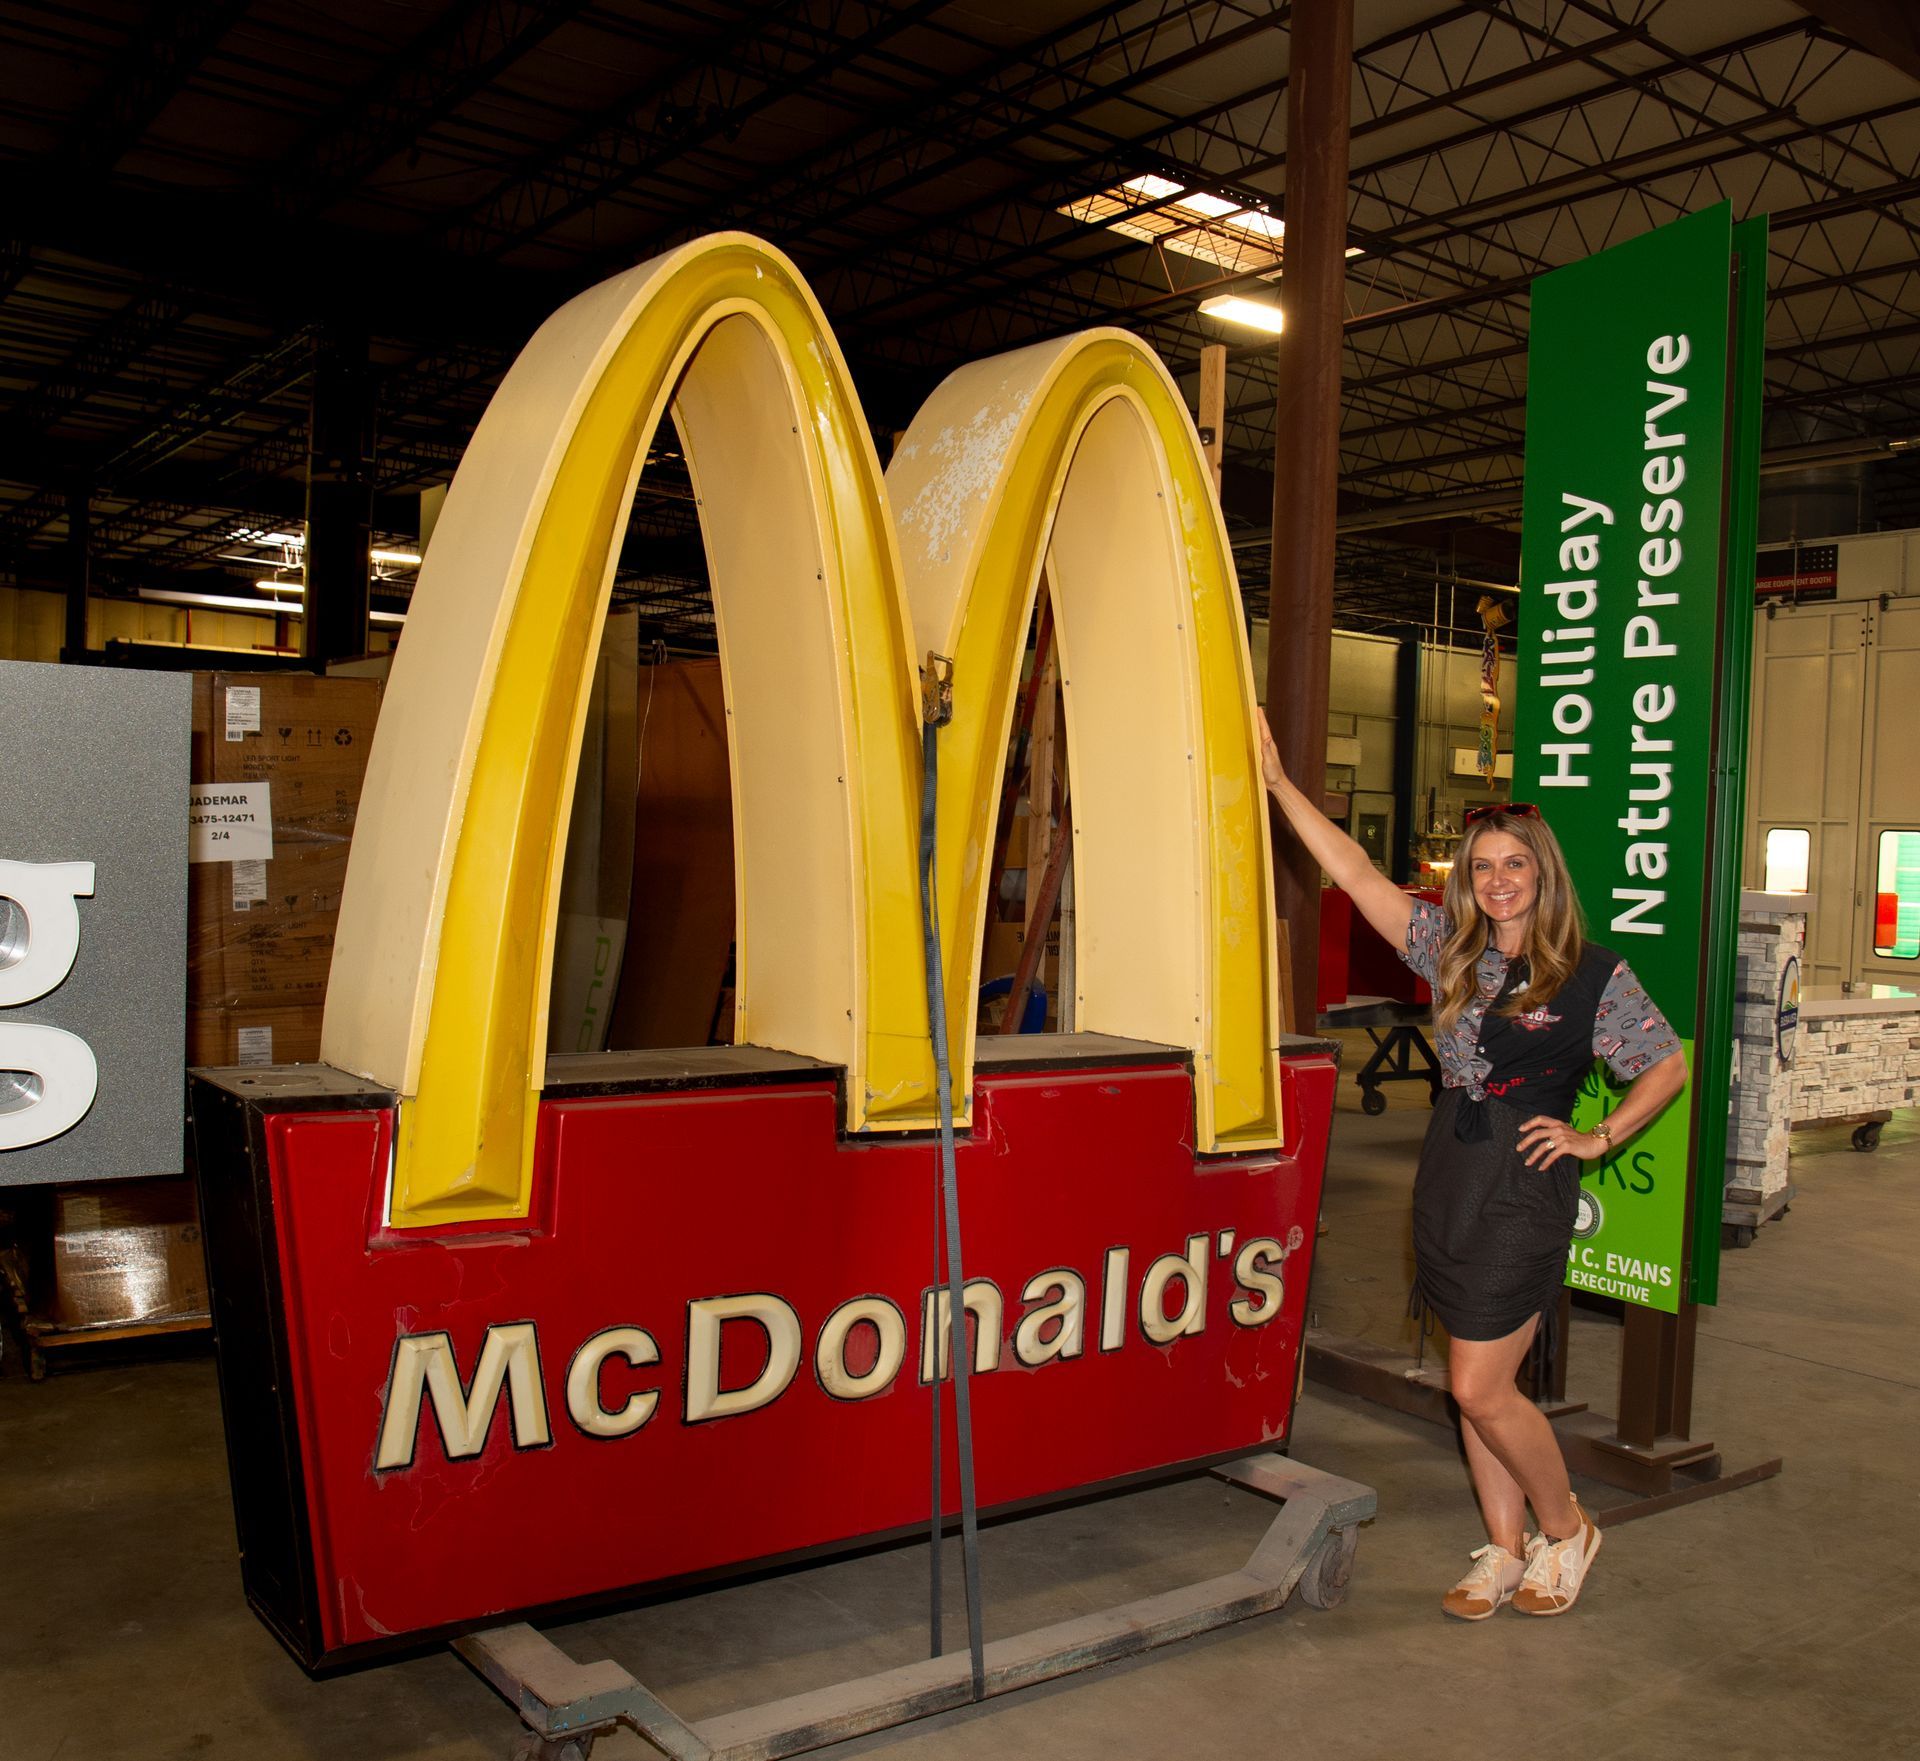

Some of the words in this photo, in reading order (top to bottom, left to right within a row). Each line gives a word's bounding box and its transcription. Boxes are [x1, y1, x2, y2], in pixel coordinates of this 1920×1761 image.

[1622, 333, 1691, 659] Preserve
[1537, 492, 1615, 788] Holliday
[190, 795, 248, 806] JADEMAR
[211, 831, 230, 841] 2/4
[1609, 682, 1677, 936] Nature
[1571, 1269, 1650, 1303] EXECUTIVE
[1582, 1247, 1600, 1270] C.
[1605, 1252, 1672, 1287] EVANS
[374, 1228, 1286, 1474] McDonald's
